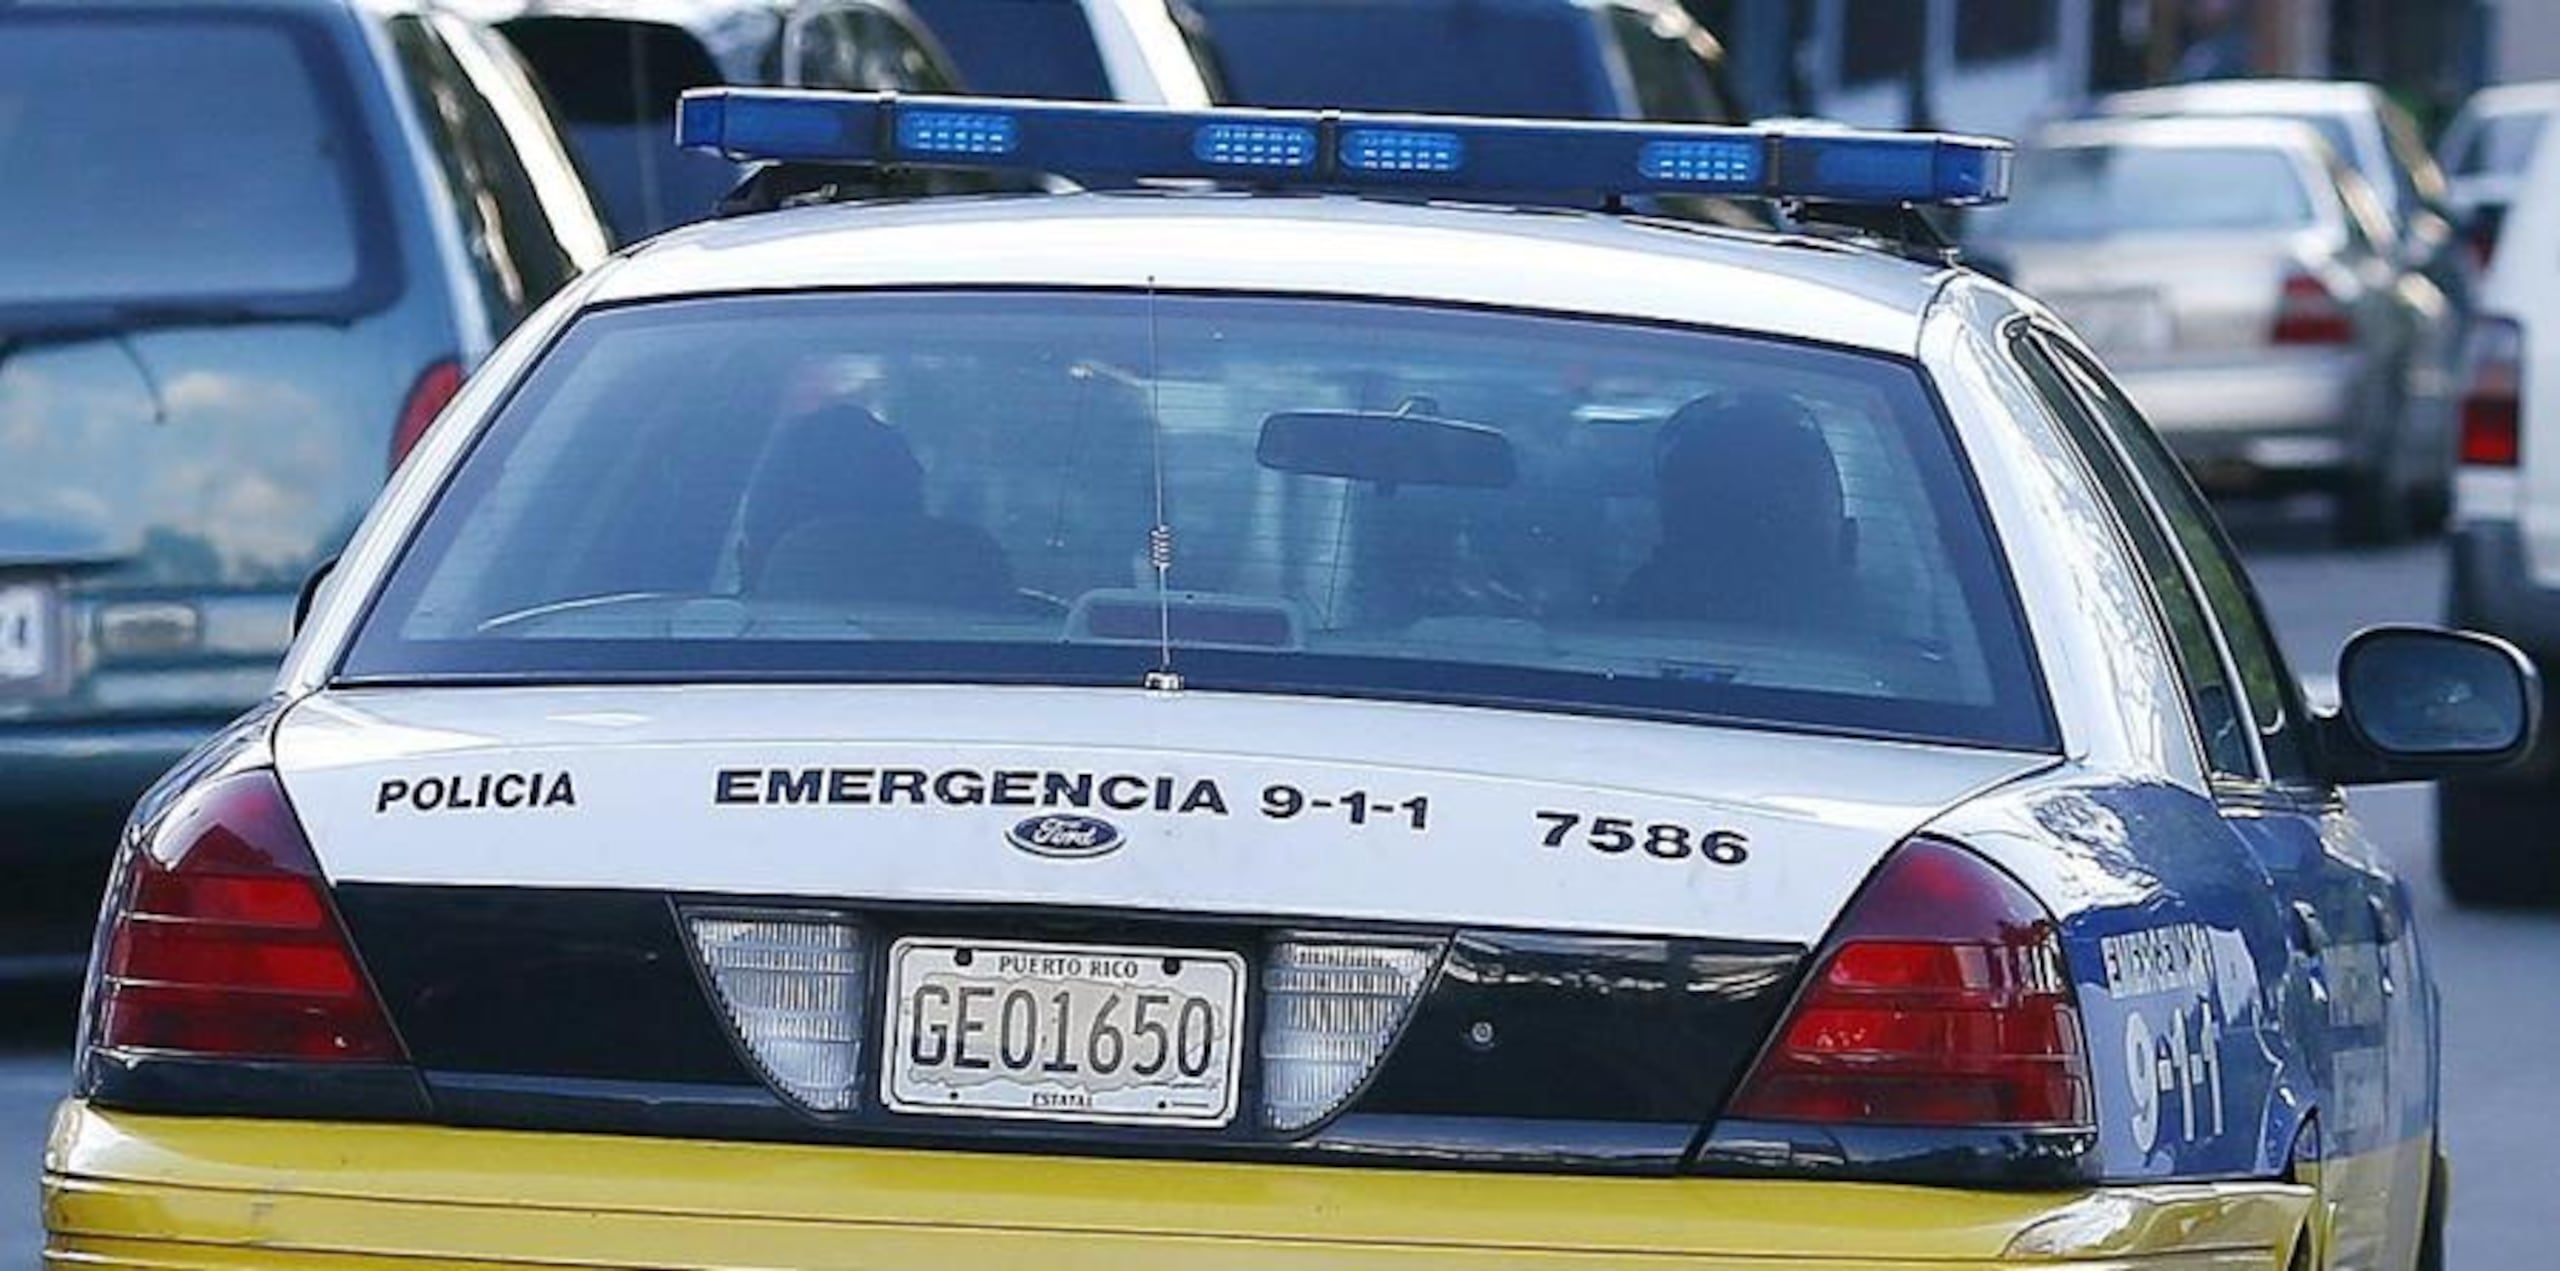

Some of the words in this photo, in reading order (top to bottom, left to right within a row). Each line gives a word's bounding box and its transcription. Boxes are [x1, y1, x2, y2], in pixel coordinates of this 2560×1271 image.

[376, 771, 577, 813] POLICIA
[714, 768, 1229, 815] EMERGENCIA
[1261, 784, 1430, 830] 9-1-1
[1032, 817, 1098, 847] Ford
[1535, 810, 1751, 866] 7586
[999, 955, 1082, 977] PUERTO
[1089, 958, 1139, 979] RICO
[910, 983, 1215, 1078] GE01650
[1031, 1091, 1094, 1109] ESTATAL
[2125, 1001, 2225, 1153] 9-1-1
